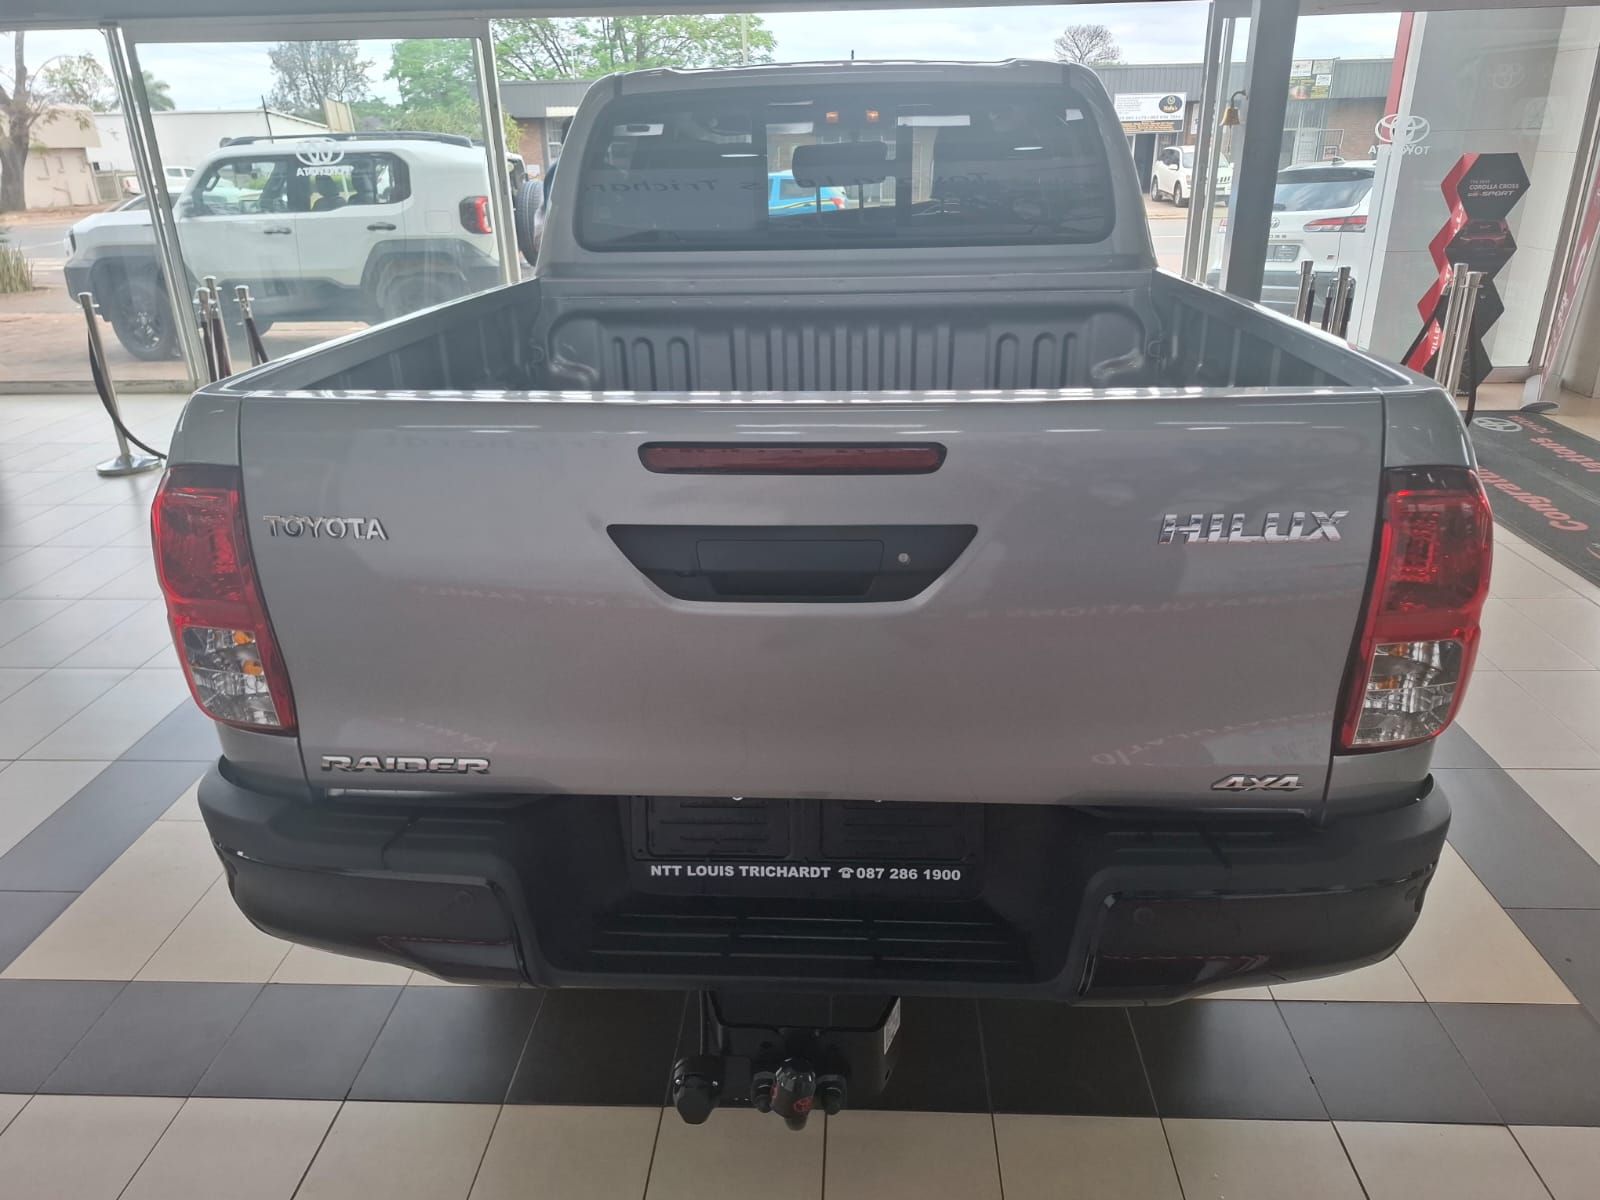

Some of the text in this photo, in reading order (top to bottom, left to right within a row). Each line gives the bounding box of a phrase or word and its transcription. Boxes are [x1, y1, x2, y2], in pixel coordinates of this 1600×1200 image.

[1478, 464, 1589, 531] Congratu
[263, 515, 389, 541] TOYOTA
[1158, 510, 1350, 545] HILUX
[321, 754, 491, 775] RAIDER
[650, 865, 961, 881] NTT LOUIS TRICHARDT 087 286 1900
